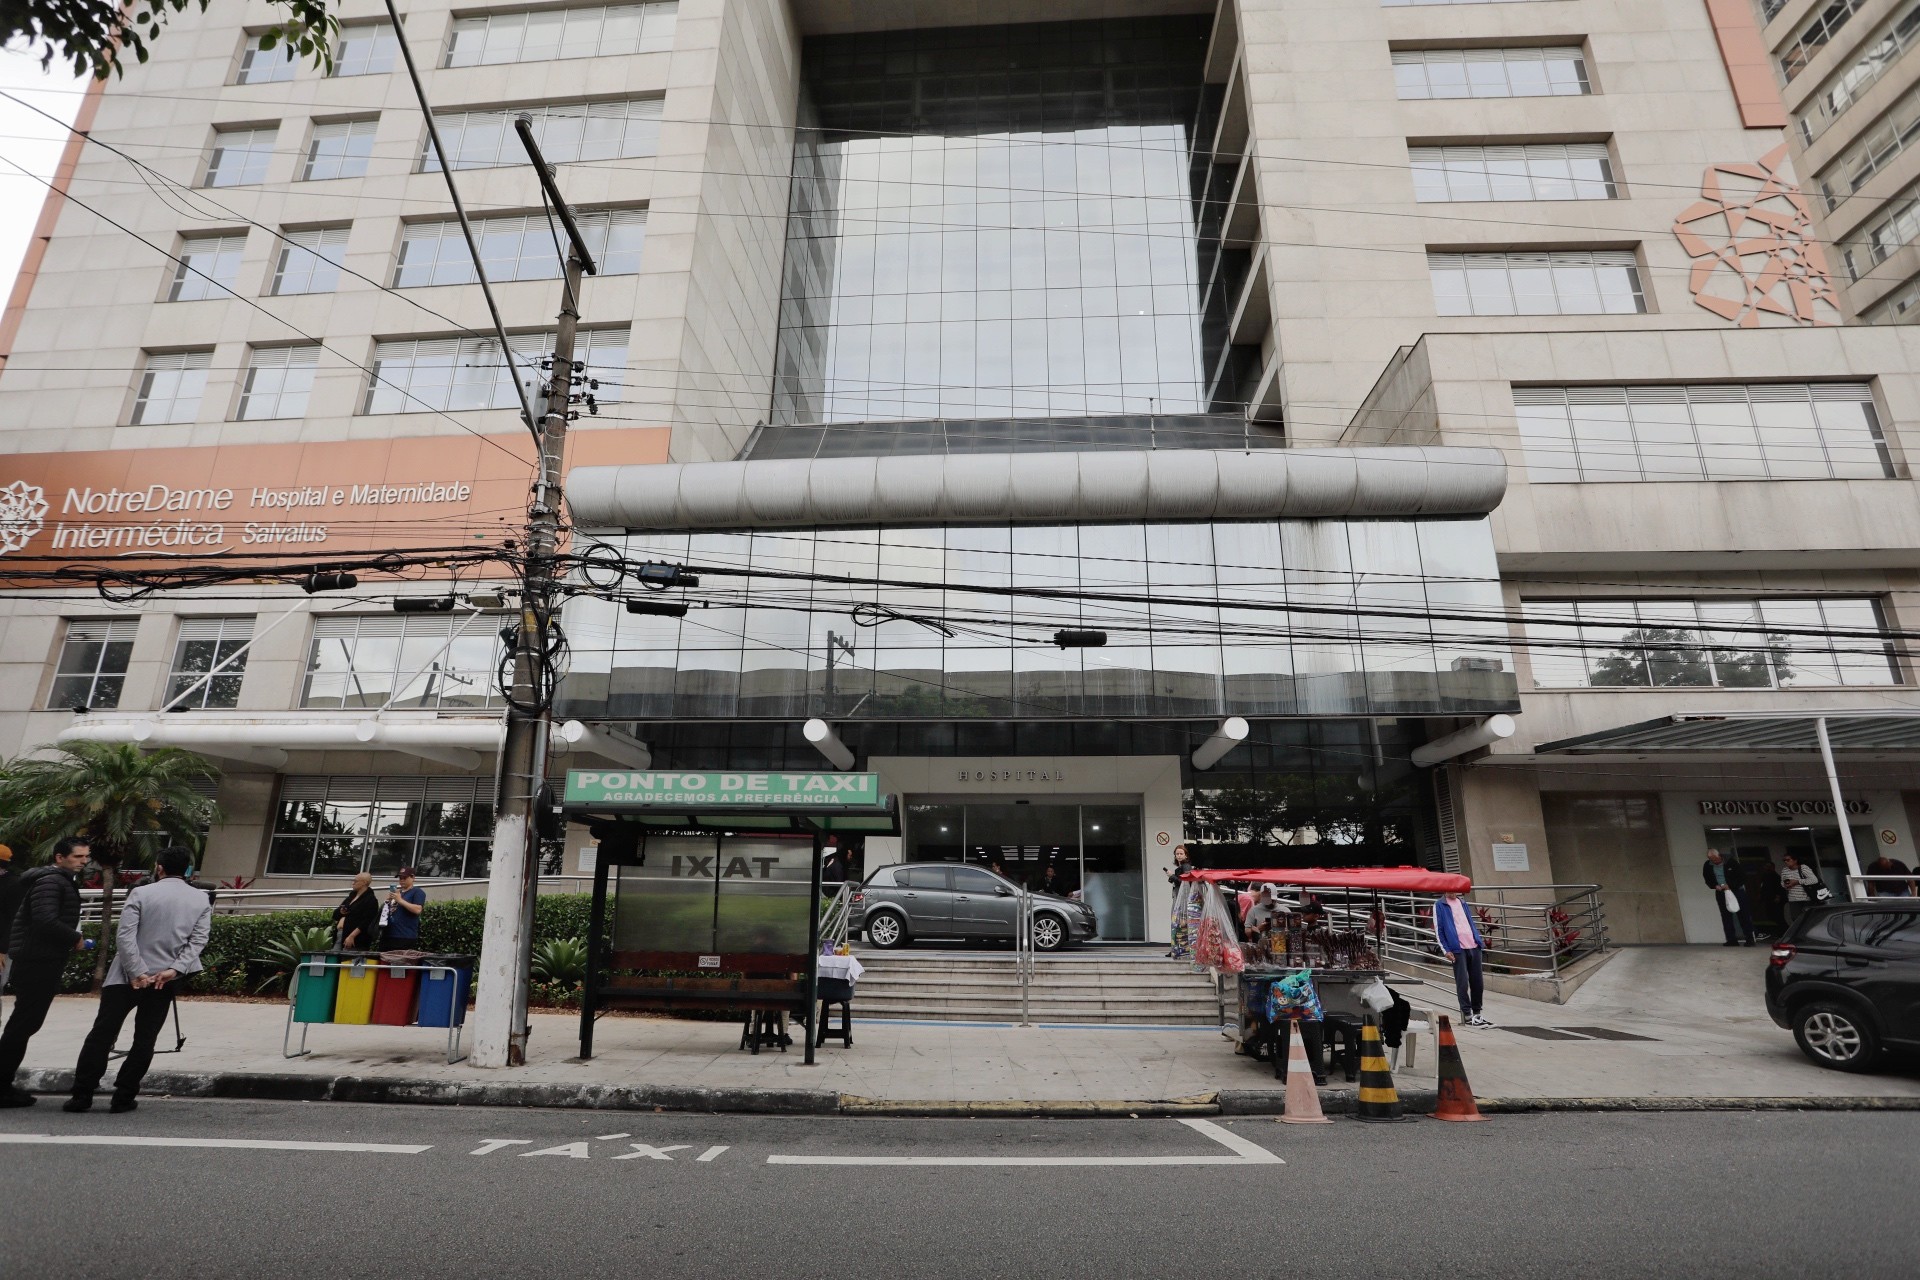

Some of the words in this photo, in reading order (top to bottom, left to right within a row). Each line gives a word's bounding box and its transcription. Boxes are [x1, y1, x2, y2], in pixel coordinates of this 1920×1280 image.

[62, 485, 233, 514] NotreDame
[250, 486, 329, 512] Hospital
[332, 489, 345, 506] e
[350, 481, 470, 505] Maternidade
[52, 519, 224, 549] Intermédica
[242, 522, 328, 544] Salvalus
[577, 773, 706, 790] PONTO
[720, 774, 768, 791] DE
[782, 775, 868, 792] TAXI
[959, 771, 1064, 780] HOSPITAL
[603, 792, 716, 802] AGRADECEMOS
[720, 793, 729, 802] A
[735, 793, 840, 803] PREFERÊNCIA
[1701, 801, 1773, 814] PRONTO
[1864, 802, 1873, 814] 2
